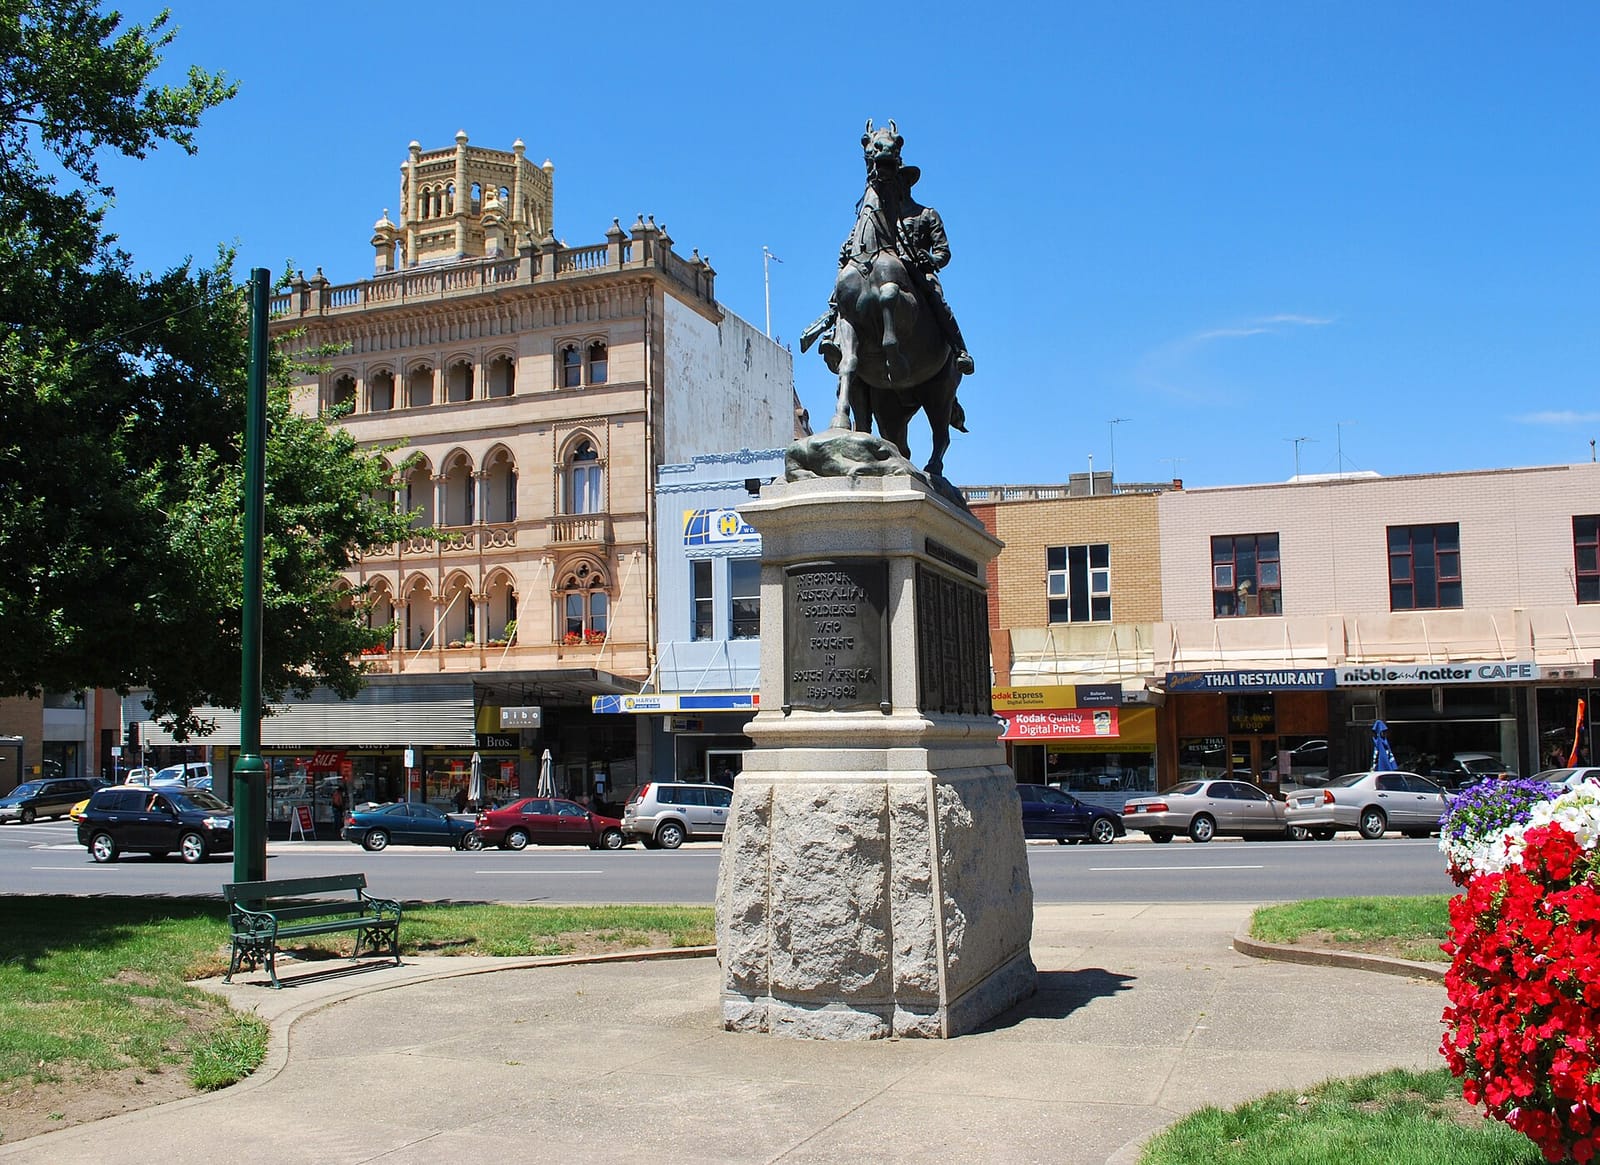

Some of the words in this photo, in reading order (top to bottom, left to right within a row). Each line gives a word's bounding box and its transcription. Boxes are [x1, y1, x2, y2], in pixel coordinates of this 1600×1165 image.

[797, 586, 870, 602] AUSTRALIAN
[805, 603, 857, 617] SOLDIERS
[814, 620, 842, 633] WHO
[810, 636, 854, 650] FOUGHT
[825, 653, 836, 666] IN
[793, 669, 824, 682] SOUTH
[828, 667, 877, 685] AFRICA
[1204, 674, 1235, 687] THAI
[1239, 671, 1325, 686] RESTAURANT
[1343, 667, 1399, 682] nibble
[1418, 667, 1472, 681] natter
[1477, 664, 1532, 679] CAFE
[807, 685, 857, 699] 1899-1902
[991, 692, 1012, 700] odak
[1012, 691, 1044, 701] Express
[502, 711, 539, 720] Bibo
[1015, 713, 1047, 723] Kodak
[1048, 712, 1083, 724] Quality
[1019, 723, 1051, 736] Digital
[1052, 723, 1081, 734] Prints
[486, 736, 513, 747] Bros.
[312, 754, 338, 767] SALE
